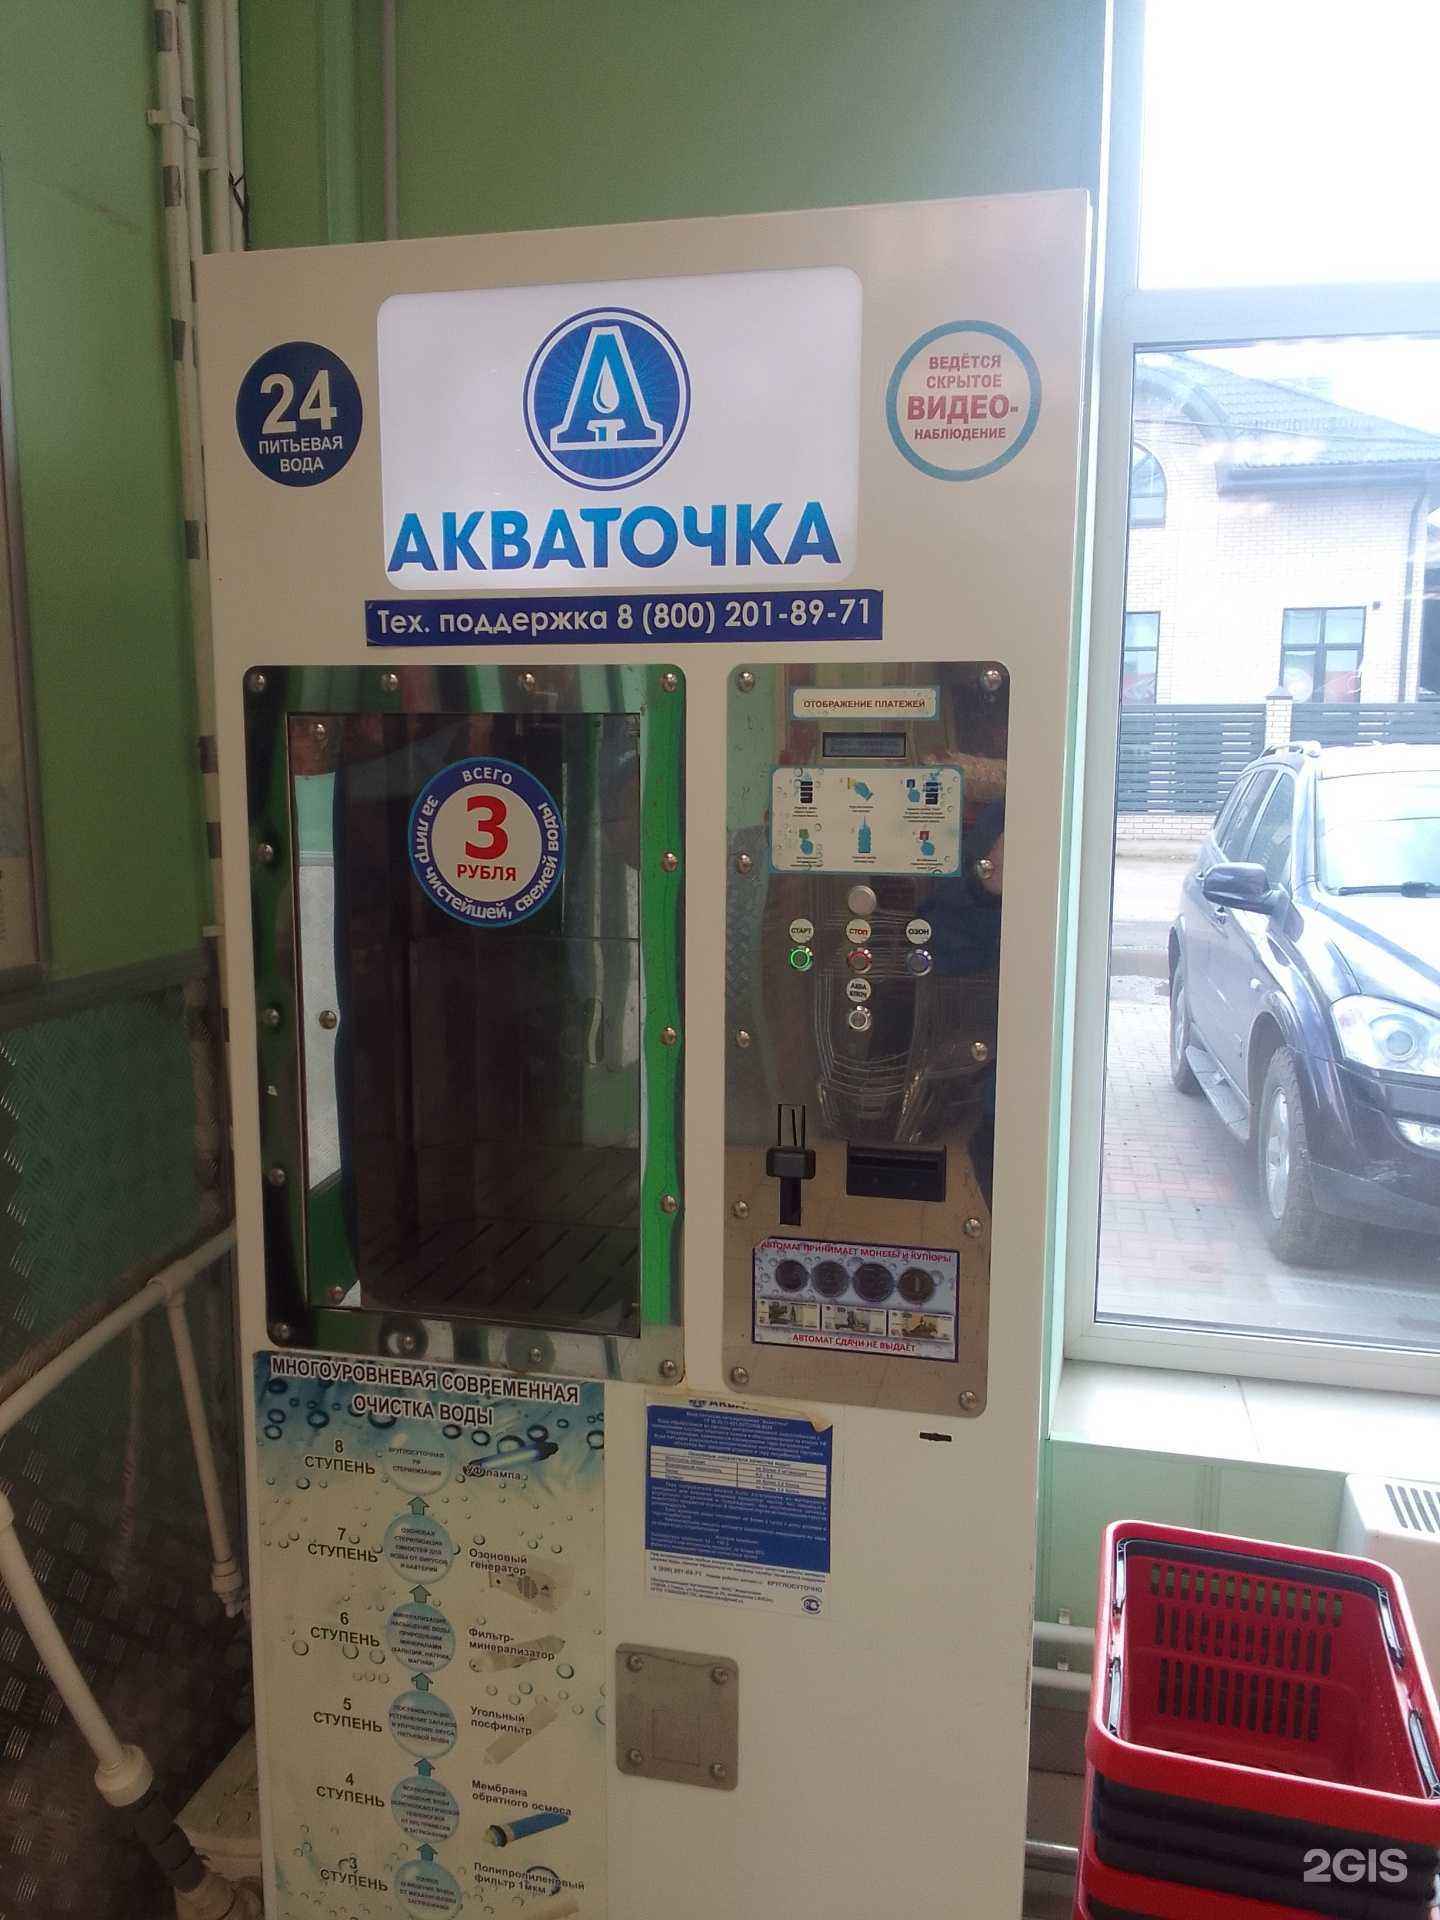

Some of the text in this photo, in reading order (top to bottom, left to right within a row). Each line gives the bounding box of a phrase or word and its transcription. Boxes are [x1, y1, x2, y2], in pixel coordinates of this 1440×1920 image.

[928, 353, 1001, 372] ВЕДЁТСЯ
[926, 374, 1003, 389] СКРЫТОЕ
[258, 369, 338, 435] 24
[907, 394, 1019, 424] ВИДЕО-
[914, 428, 1007, 441] НАБЛЮДЕНИЕ
[258, 434, 344, 456] ПИТЬЕВАЯ
[280, 457, 324, 474] ВОДА
[387, 500, 842, 573] АКВАТОЧКА
[377, 597, 872, 642] Тех. поддержка 8 (800) 201-89-71
[803, 698, 926, 709] ОТОБРАЖЕНИЕ ПЛАТЕЖЕЙ
[461, 767, 513, 785] ВСЕГО
[465, 795, 509, 860] 3
[415, 794, 560, 919] за литр чистейшей, свежей воды
[456, 863, 517, 882] РУБЛЯ
[791, 927, 812, 935] СТАРТ
[860, 1248, 900, 1260] МОНЕТЫ
[901, 1251, 909, 1259] И
[910, 1251, 952, 1264] КУПЮРЫ
[792, 1334, 833, 1345] АВТОМАТ
[835, 1337, 865, 1347] СДАЧИ
[866, 1341, 879, 1349] НЕ
[270, 1357, 580, 1404] МНОГОУРОВНЕВАЯ СОВРЕМЕННАЯ
[353, 1395, 494, 1426] ОЧИСТКА ВОДЫ
[334, 1440, 345, 1453] 8
[304, 1455, 376, 1476] СТУПЕНЬ
[337, 1528, 347, 1541] 7
[307, 1543, 379, 1563] СТУПЕНЬ
[469, 1548, 528, 1564] Озоновый
[470, 1561, 527, 1576] генератор
[340, 1612, 350, 1625] 6
[310, 1627, 381, 1648] СТУПЕНЬ
[468, 1627, 515, 1643] Фильтр-
[469, 1641, 556, 1661] минерализатор
[343, 1698, 353, 1711] 5
[470, 1705, 526, 1722] Угольный
[313, 1712, 383, 1733] СТУПЕНЬ
[471, 1719, 533, 1736] посфильтр
[346, 1773, 355, 1785] 4
[316, 1786, 386, 1808] СТУПЕНЬ
[472, 1780, 528, 1797] Мембрана
[472, 1792, 572, 1816] обратного осмоса
[349, 1857, 359, 1870] 3
[320, 1868, 389, 1892] СТУПЕНЬ
[474, 1862, 585, 1891] Полипропиленовый
[474, 1873, 516, 1890] фильтр
